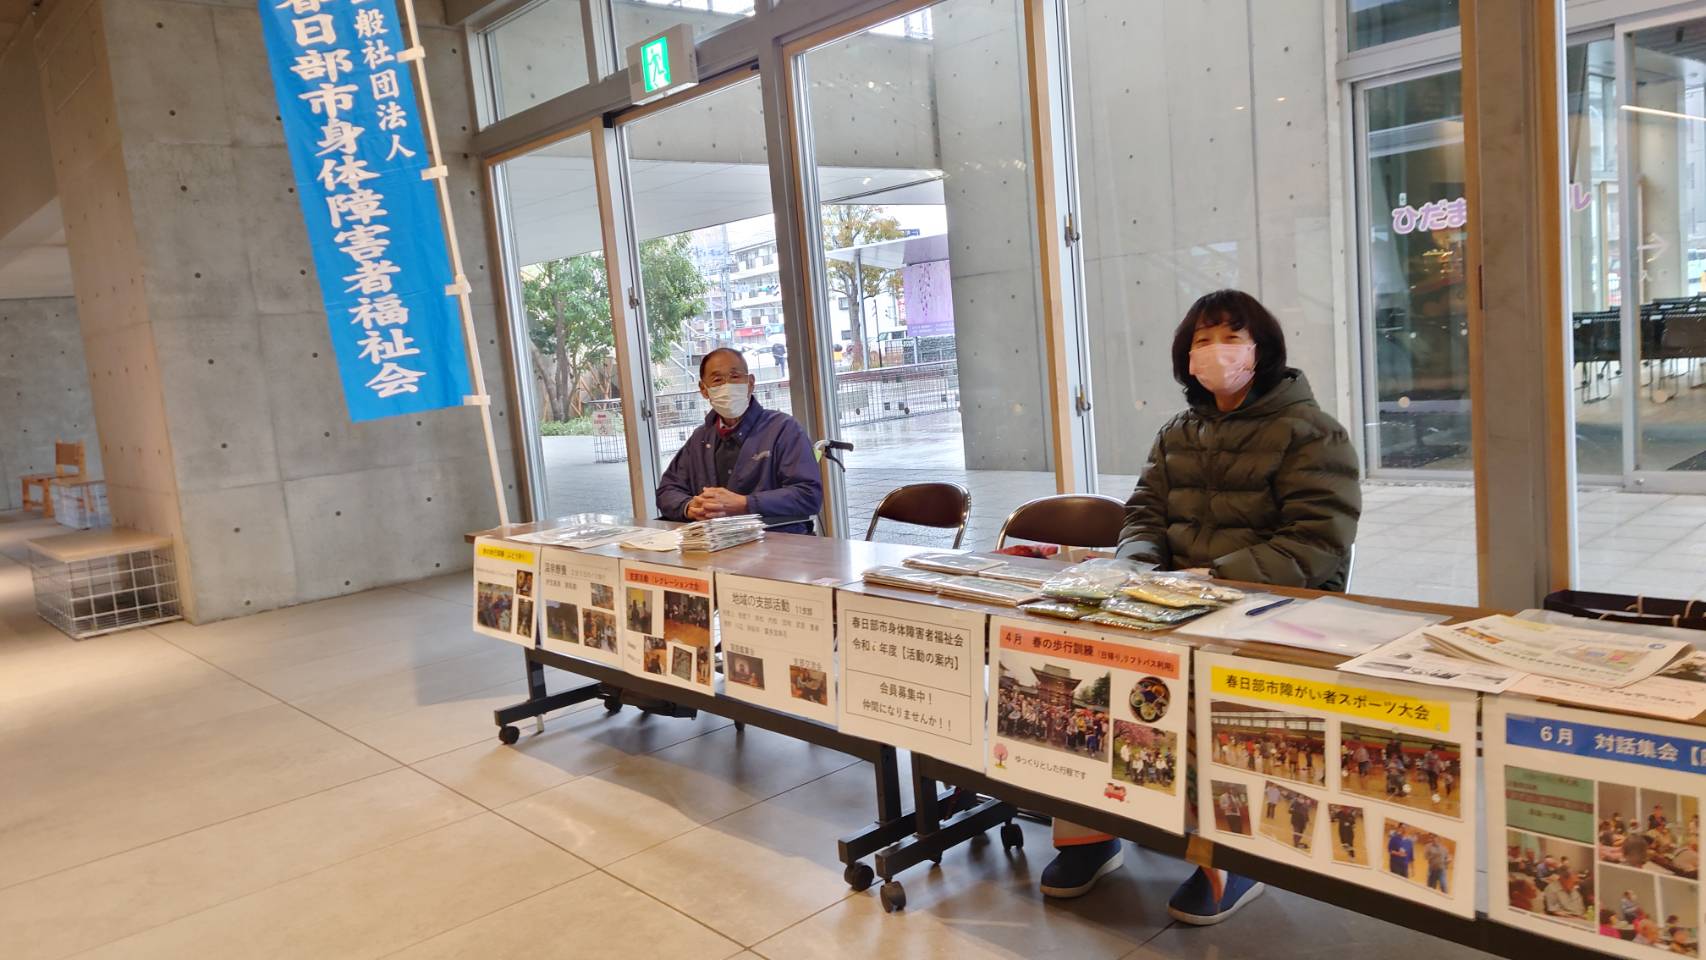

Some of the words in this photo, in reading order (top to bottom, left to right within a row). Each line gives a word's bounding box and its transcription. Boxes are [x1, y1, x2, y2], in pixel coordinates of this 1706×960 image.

[350, 0, 416, 161] 般社団法人
[732, 592, 790, 613] 地域の支部活動
[852, 616, 964, 648] 春日部市身体障害者福祉会
[1032, 635, 1094, 658] 春の歩行訓練
[879, 682, 932, 705] 会員募集中！
[1226, 673, 1430, 721] 春日部市障がい者スポーツ大会
[1594, 733, 1706, 767] 対話集会【
[1014, 755, 1087, 781] ゆっくりとした行程です
